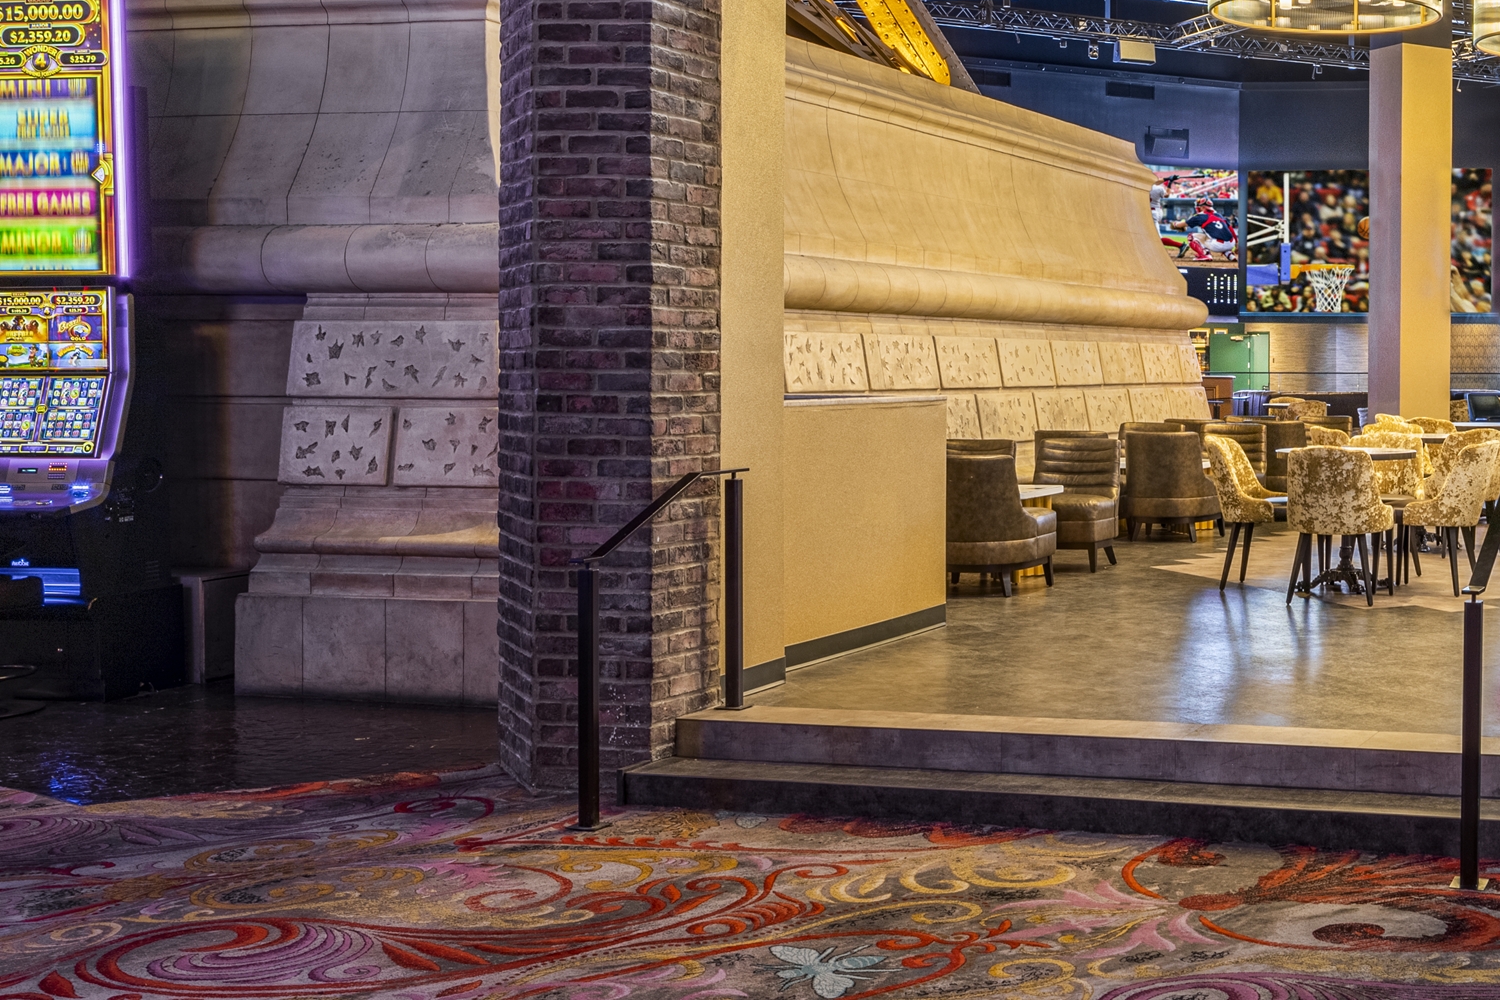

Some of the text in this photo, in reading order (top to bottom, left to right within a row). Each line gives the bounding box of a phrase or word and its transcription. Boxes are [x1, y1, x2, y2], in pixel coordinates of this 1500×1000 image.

[10, 30, 71, 44] $2,359.20
[24, 45, 58, 57] WONDER
[35, 53, 47, 67] 4
[70, 56, 97, 64] $25.79
[37, 191, 91, 216] GAMES
[2, 230, 62, 255] MINOR
